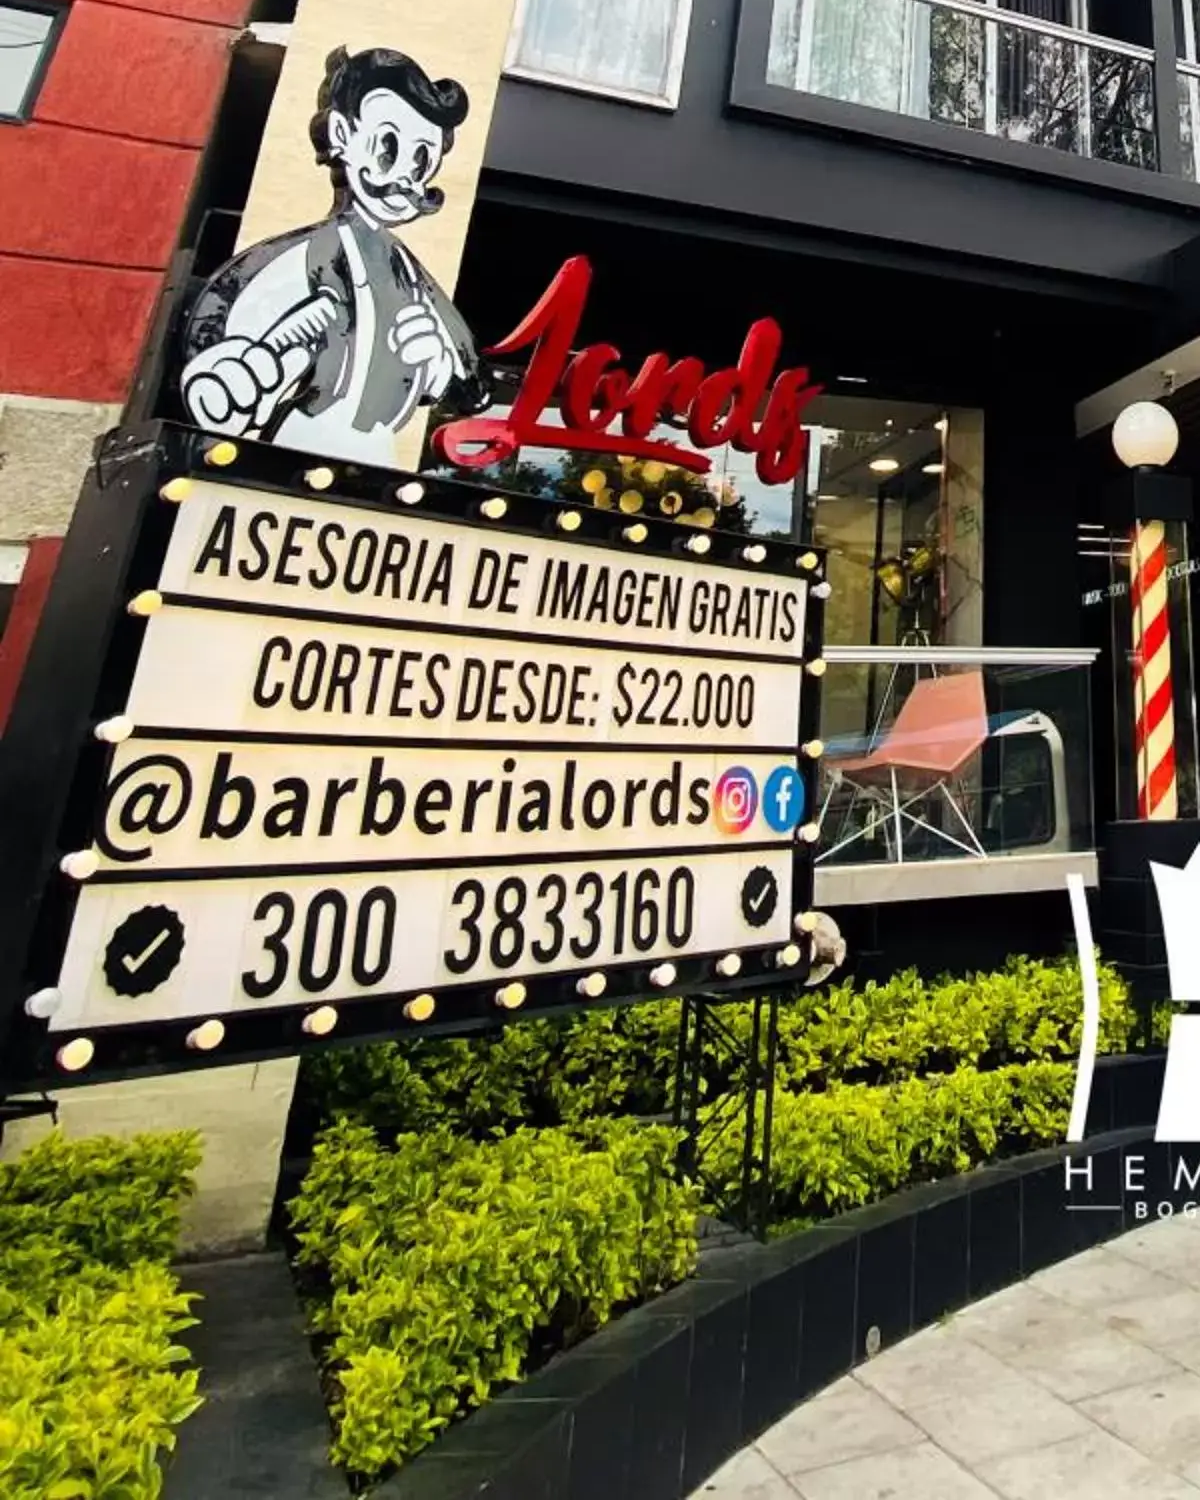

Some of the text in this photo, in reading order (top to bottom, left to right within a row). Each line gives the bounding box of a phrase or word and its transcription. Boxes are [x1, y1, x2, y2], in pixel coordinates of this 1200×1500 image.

[431, 254, 825, 486] Lords
[194, 505, 798, 642] ASESORIA DE IMAGEN GRATIS
[252, 636, 754, 729] CORTES DESDE: $22.000
[93, 752, 711, 862] @barberialords
[241, 865, 695, 1000] 300 3833160
